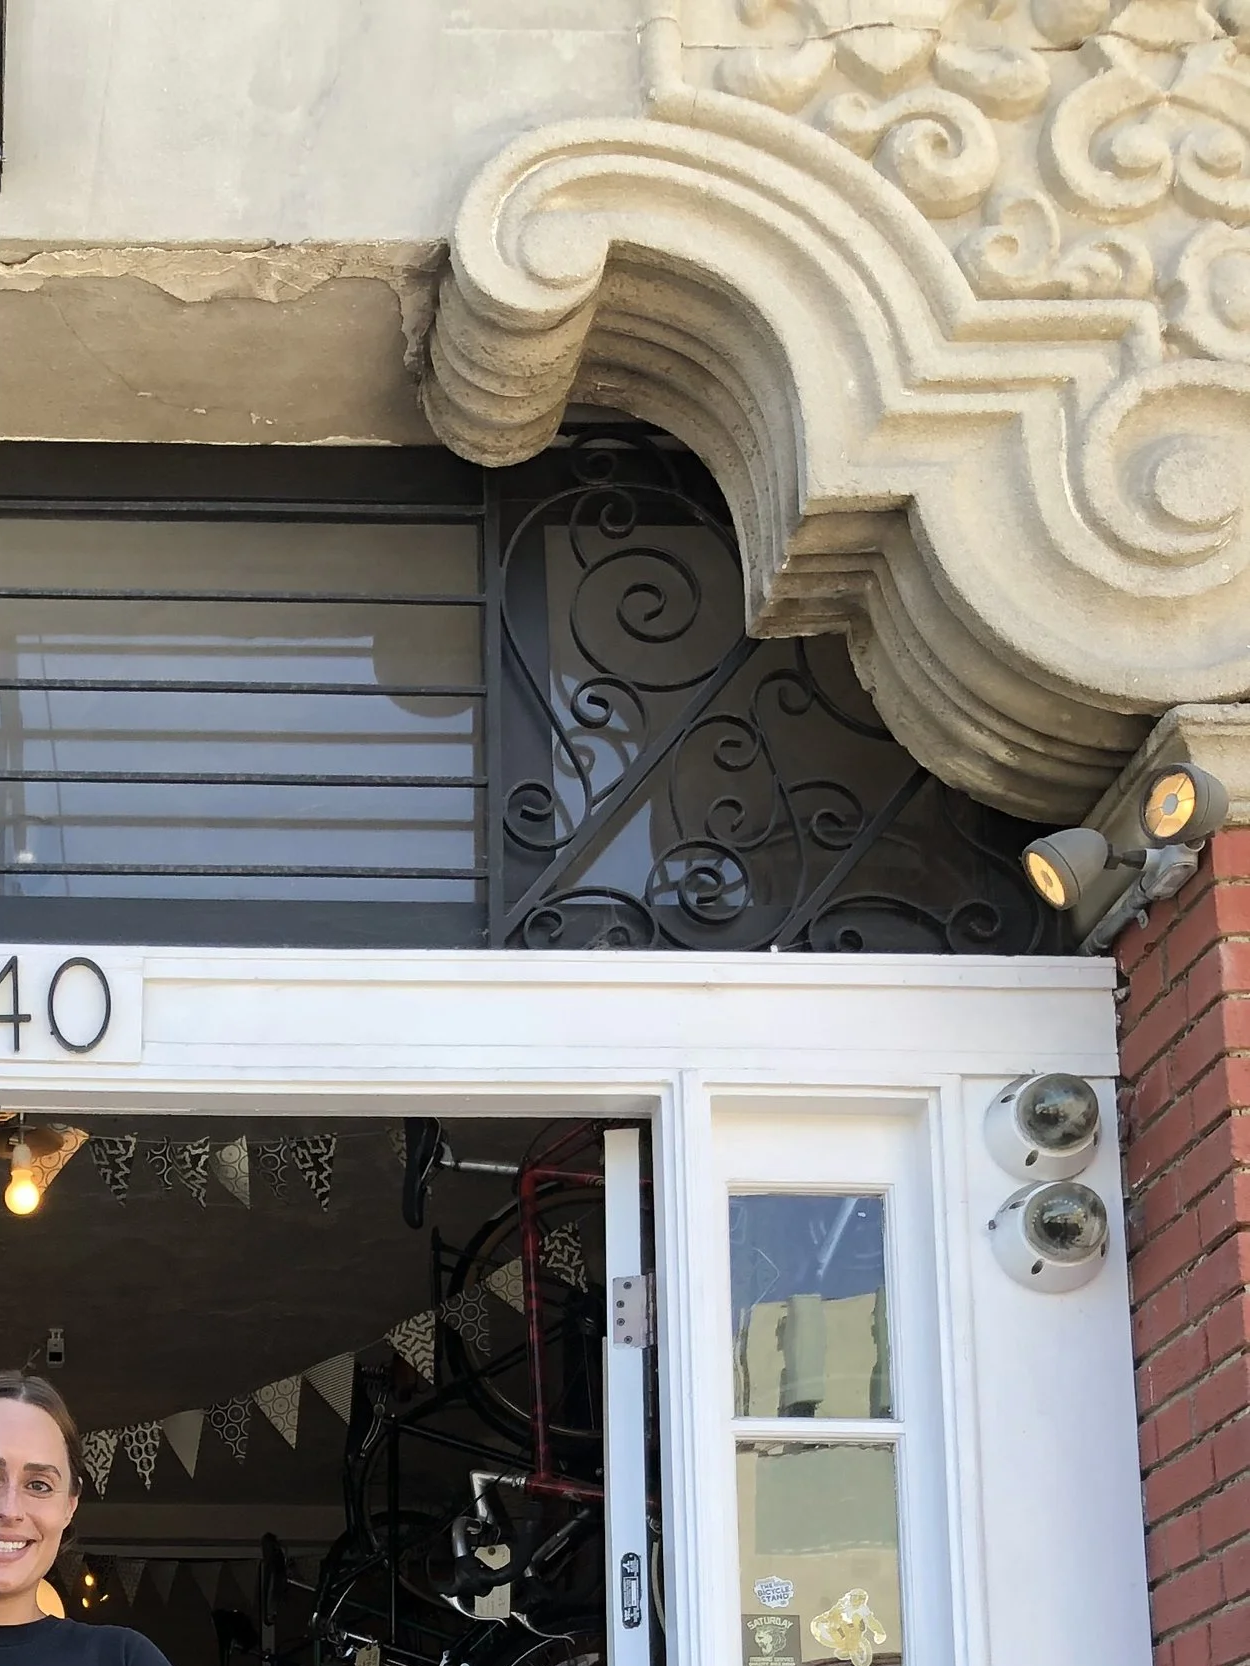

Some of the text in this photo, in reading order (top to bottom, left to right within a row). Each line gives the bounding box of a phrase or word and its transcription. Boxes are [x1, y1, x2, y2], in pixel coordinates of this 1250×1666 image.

[757, 1585, 790, 1597] BICYCLE
[761, 1593, 789, 1602] STAND
[747, 1616, 794, 1630] SATURDAY
